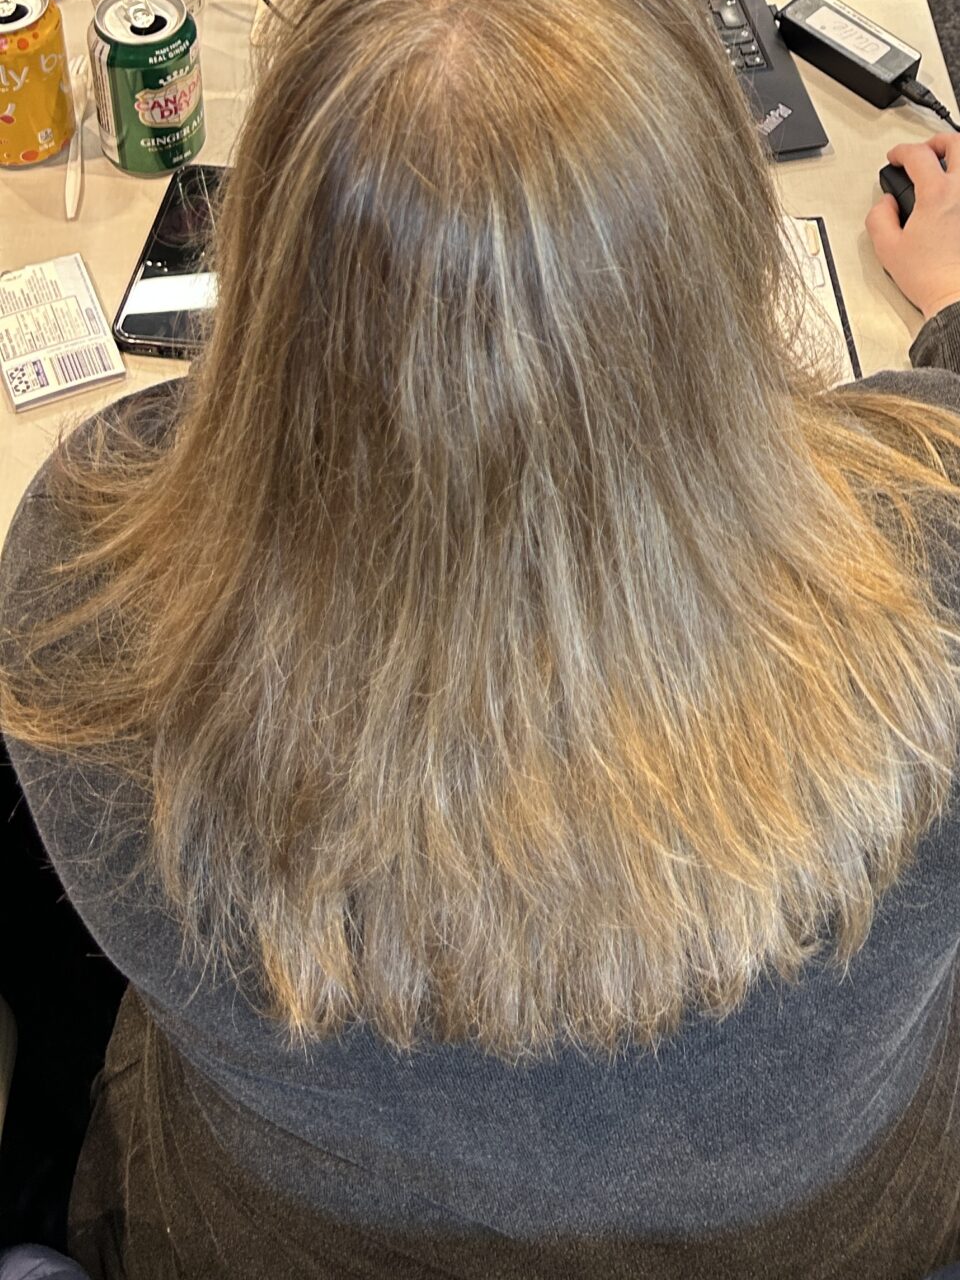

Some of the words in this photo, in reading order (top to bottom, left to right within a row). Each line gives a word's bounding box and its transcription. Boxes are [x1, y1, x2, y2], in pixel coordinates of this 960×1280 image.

[148, 52, 167, 64] REAL
[136, 70, 201, 112] CANAD
[160, 99, 190, 120] DRY
[140, 124, 190, 148] GINGER
